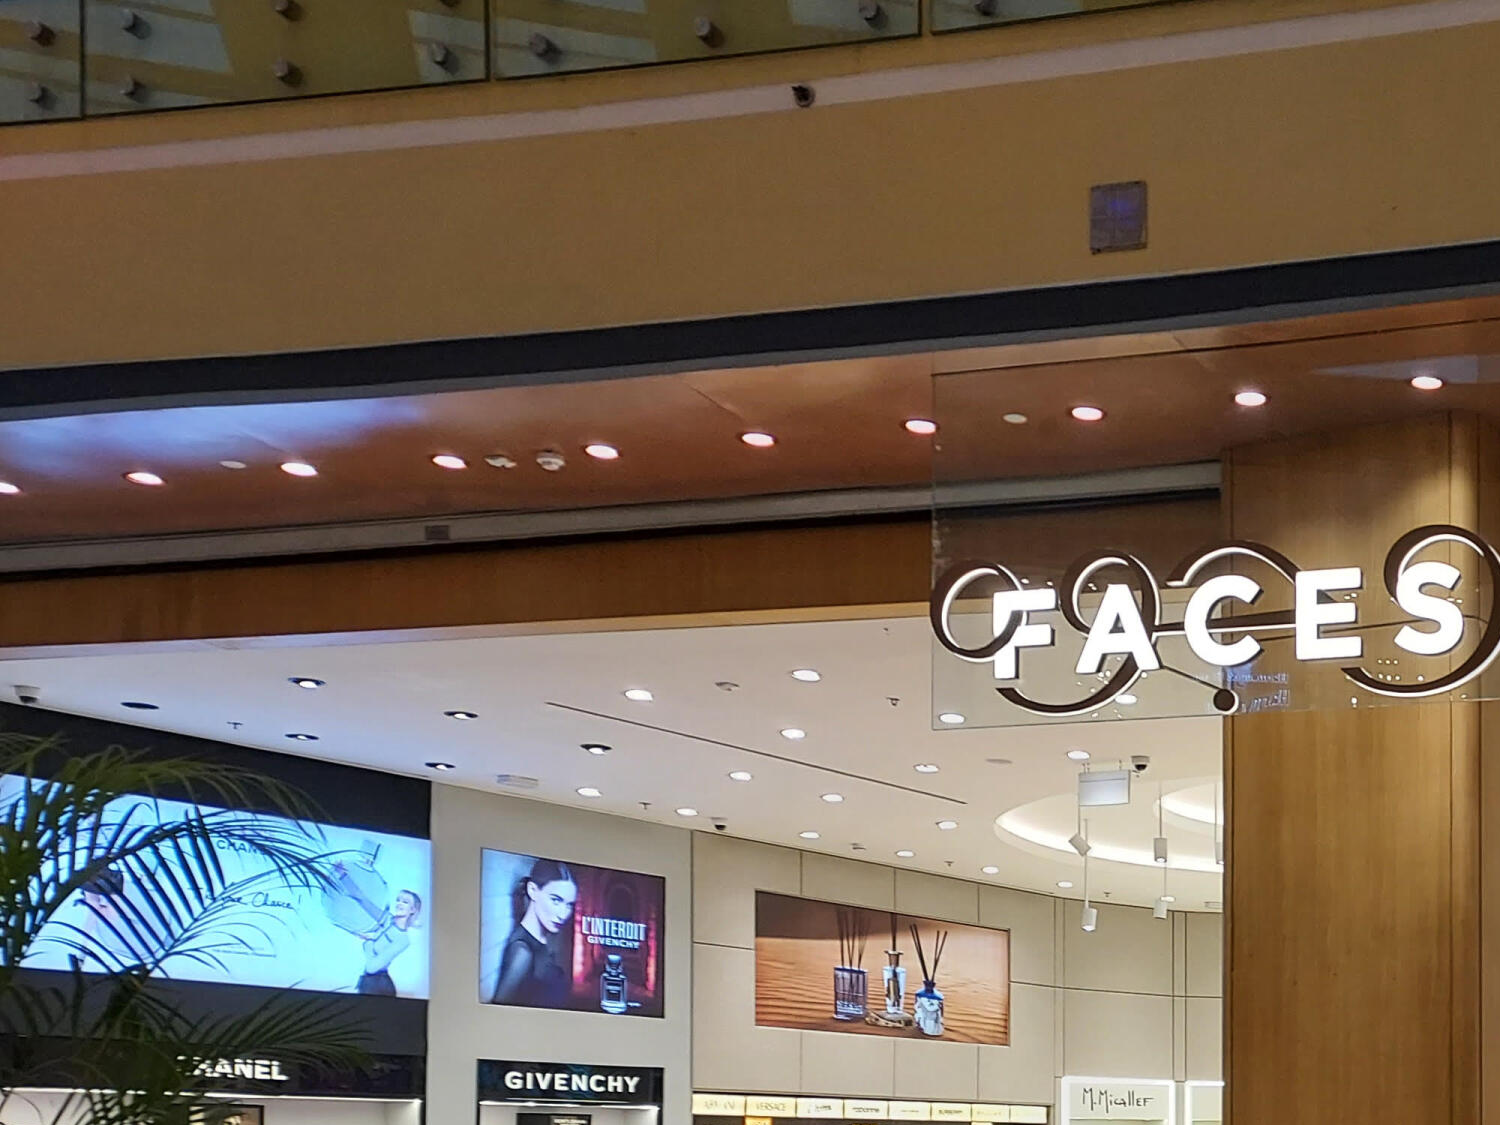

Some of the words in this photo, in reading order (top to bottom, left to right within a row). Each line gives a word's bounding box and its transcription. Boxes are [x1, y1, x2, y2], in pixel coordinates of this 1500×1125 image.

[992, 560, 1465, 681] FACES
[582, 916, 647, 941] L'INTERDIT
[587, 935, 640, 949] GIVENCHY
[504, 1071, 640, 1093] GIVENCHY
